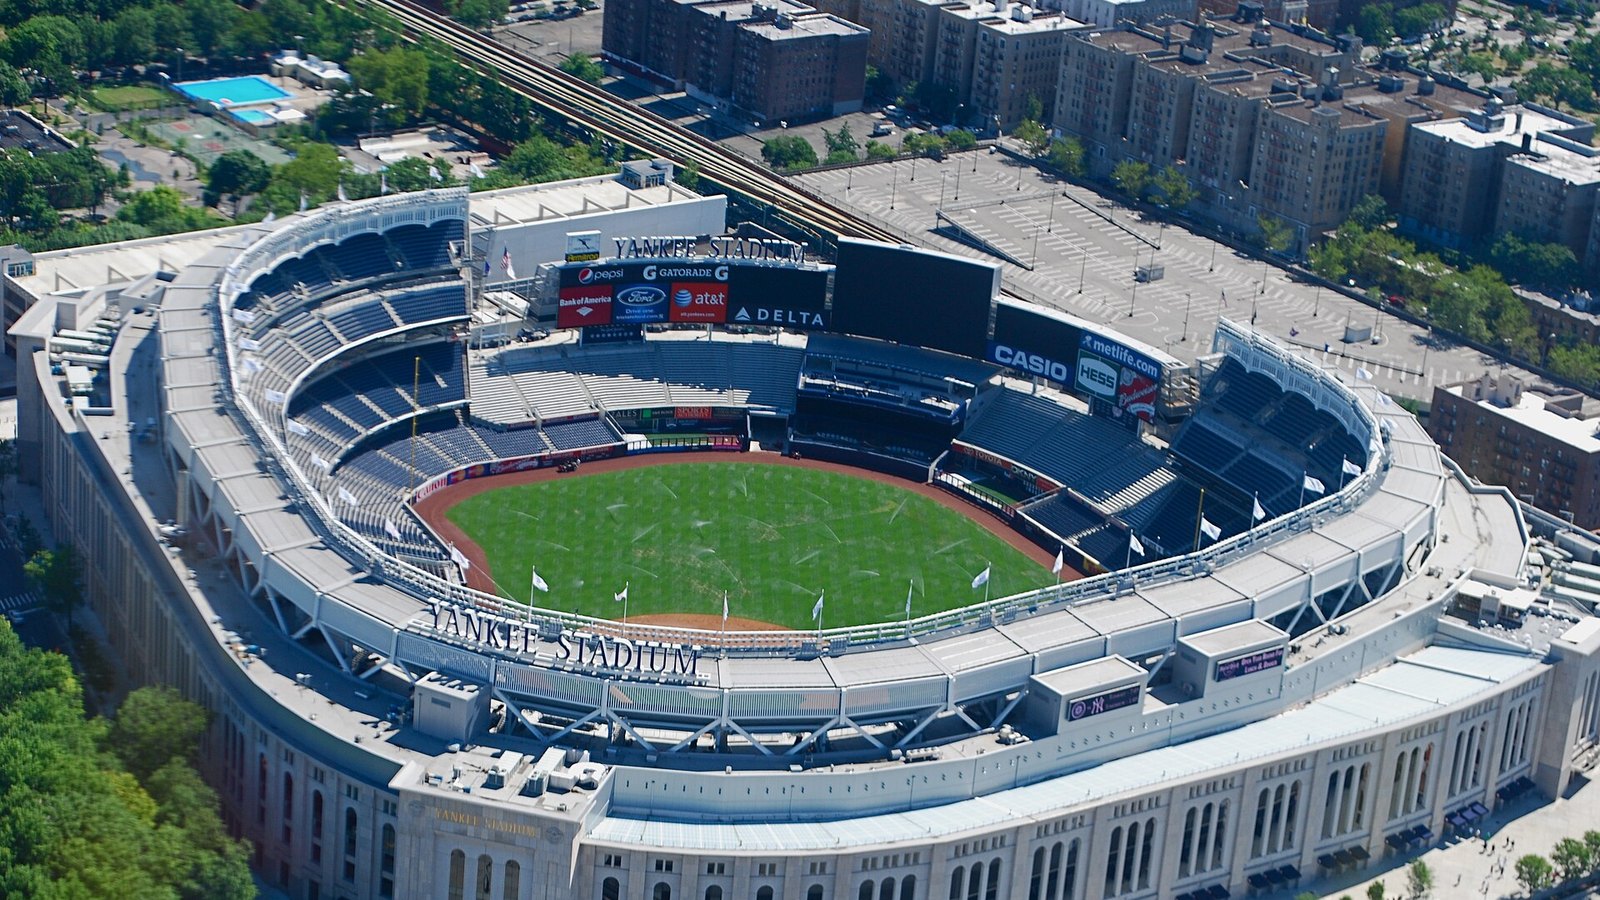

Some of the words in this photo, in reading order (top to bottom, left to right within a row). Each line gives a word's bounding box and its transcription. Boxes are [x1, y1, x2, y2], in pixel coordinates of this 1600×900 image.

[612, 236, 697, 260] YANKEE
[708, 237, 808, 263] STADIUM
[594, 268, 624, 281] pepsi
[659, 268, 712, 278] GATORADE
[560, 299, 577, 307] Bank
[577, 297, 584, 305] of
[584, 296, 612, 304] America
[627, 290, 655, 303] Ford
[695, 291, 725, 305] at&t
[757, 308, 824, 327] DELTA
[995, 345, 1068, 382] CASIO
[1093, 339, 1158, 378] metlife.com
[1080, 364, 1115, 390] HESS
[975, 450, 1003, 466] TOYOTA
[1011, 466, 1037, 480] DKNY
[416, 477, 448, 499] Canon
[428, 598, 541, 653] YANKEE
[555, 629, 703, 675] STADIUM
[436, 808, 479, 826] YANKEE
[485, 818, 537, 837] STADIUM
